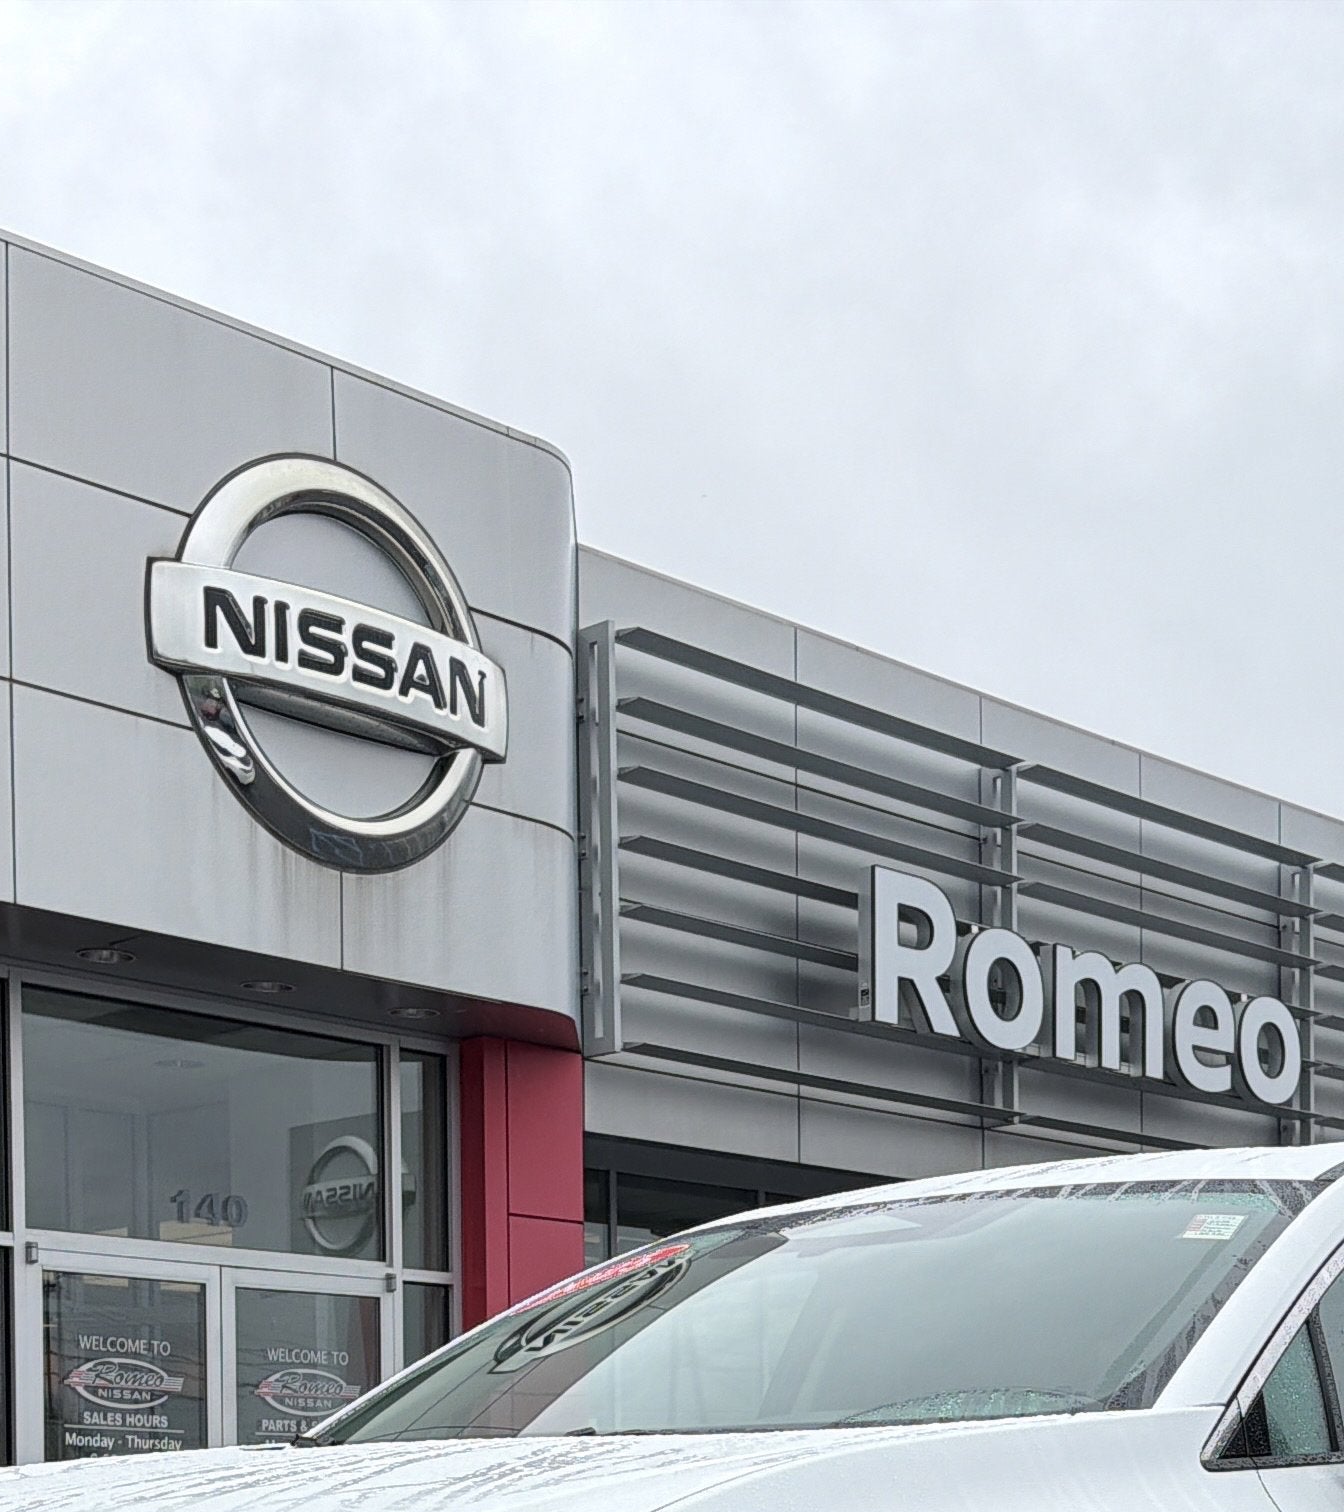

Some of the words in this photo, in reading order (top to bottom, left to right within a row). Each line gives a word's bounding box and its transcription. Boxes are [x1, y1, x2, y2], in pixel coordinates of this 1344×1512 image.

[203, 585, 488, 729] NISSAN
[869, 863, 1303, 1106] Romeo
[170, 1189, 248, 1229] 140
[79, 1334, 148, 1354] WELCOME
[151, 1340, 171, 1356] TO
[267, 1348, 329, 1365] WELCOME
[331, 1351, 349, 1366] TO
[86, 1360, 165, 1386] Romeo
[275, 1372, 344, 1395] Romeo
[97, 1388, 151, 1401] NISSAN
[284, 1397, 332, 1408] NISSAN
[83, 1411, 122, 1426] SALES
[126, 1413, 168, 1428] HOURS
[261, 1419, 297, 1432] PARTS
[300, 1420, 308, 1431] &
[65, 1431, 115, 1450] Monday
[125, 1434, 182, 1450] Thursday
